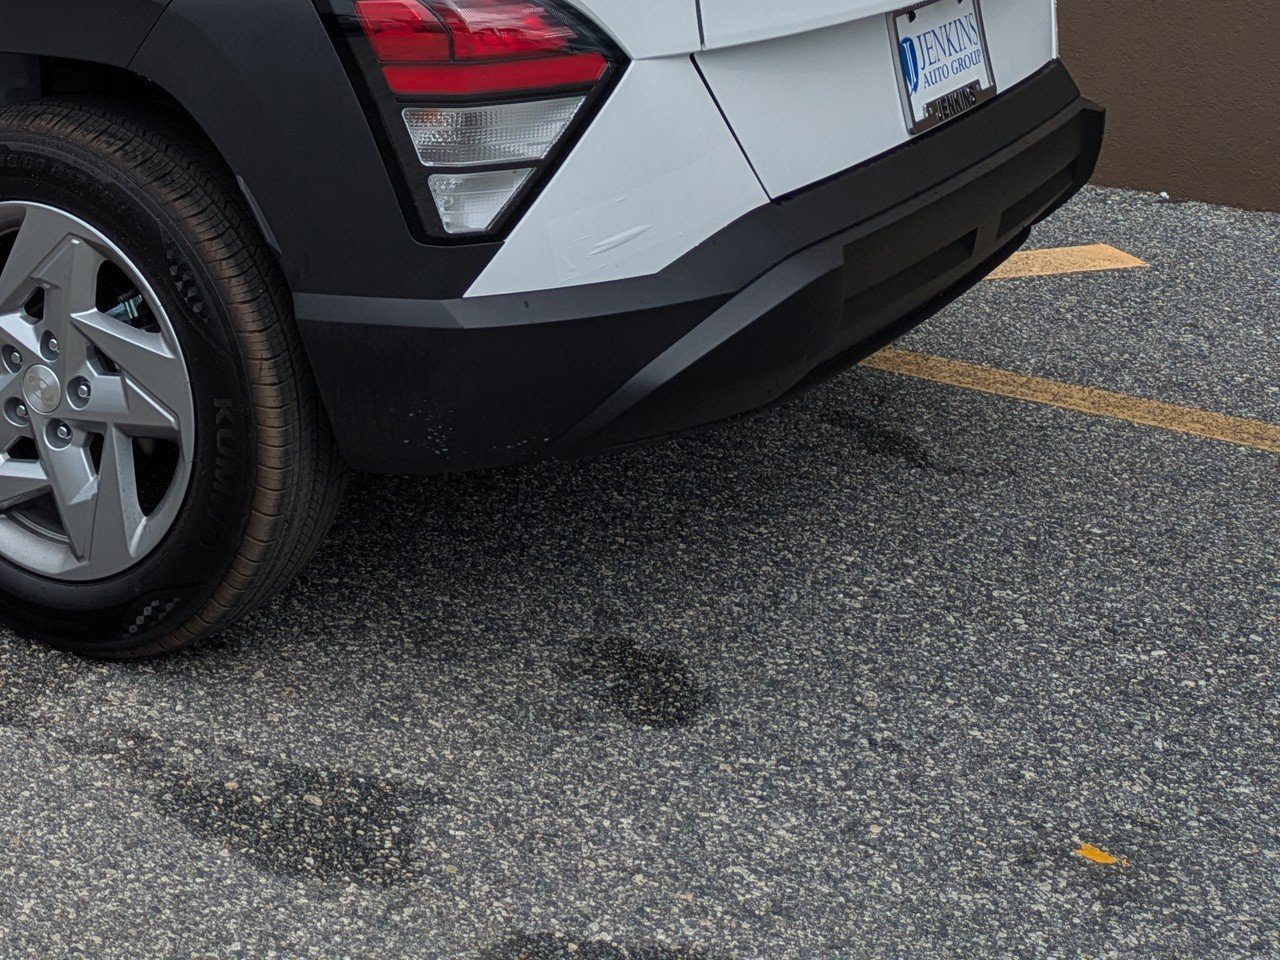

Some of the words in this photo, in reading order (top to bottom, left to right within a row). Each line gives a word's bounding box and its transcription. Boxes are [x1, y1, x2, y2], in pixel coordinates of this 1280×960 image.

[916, 12, 978, 70] JENKINS
[923, 64, 949, 89] AUTO
[951, 49, 981, 75] GROUP
[936, 85, 977, 120] JENKINS
